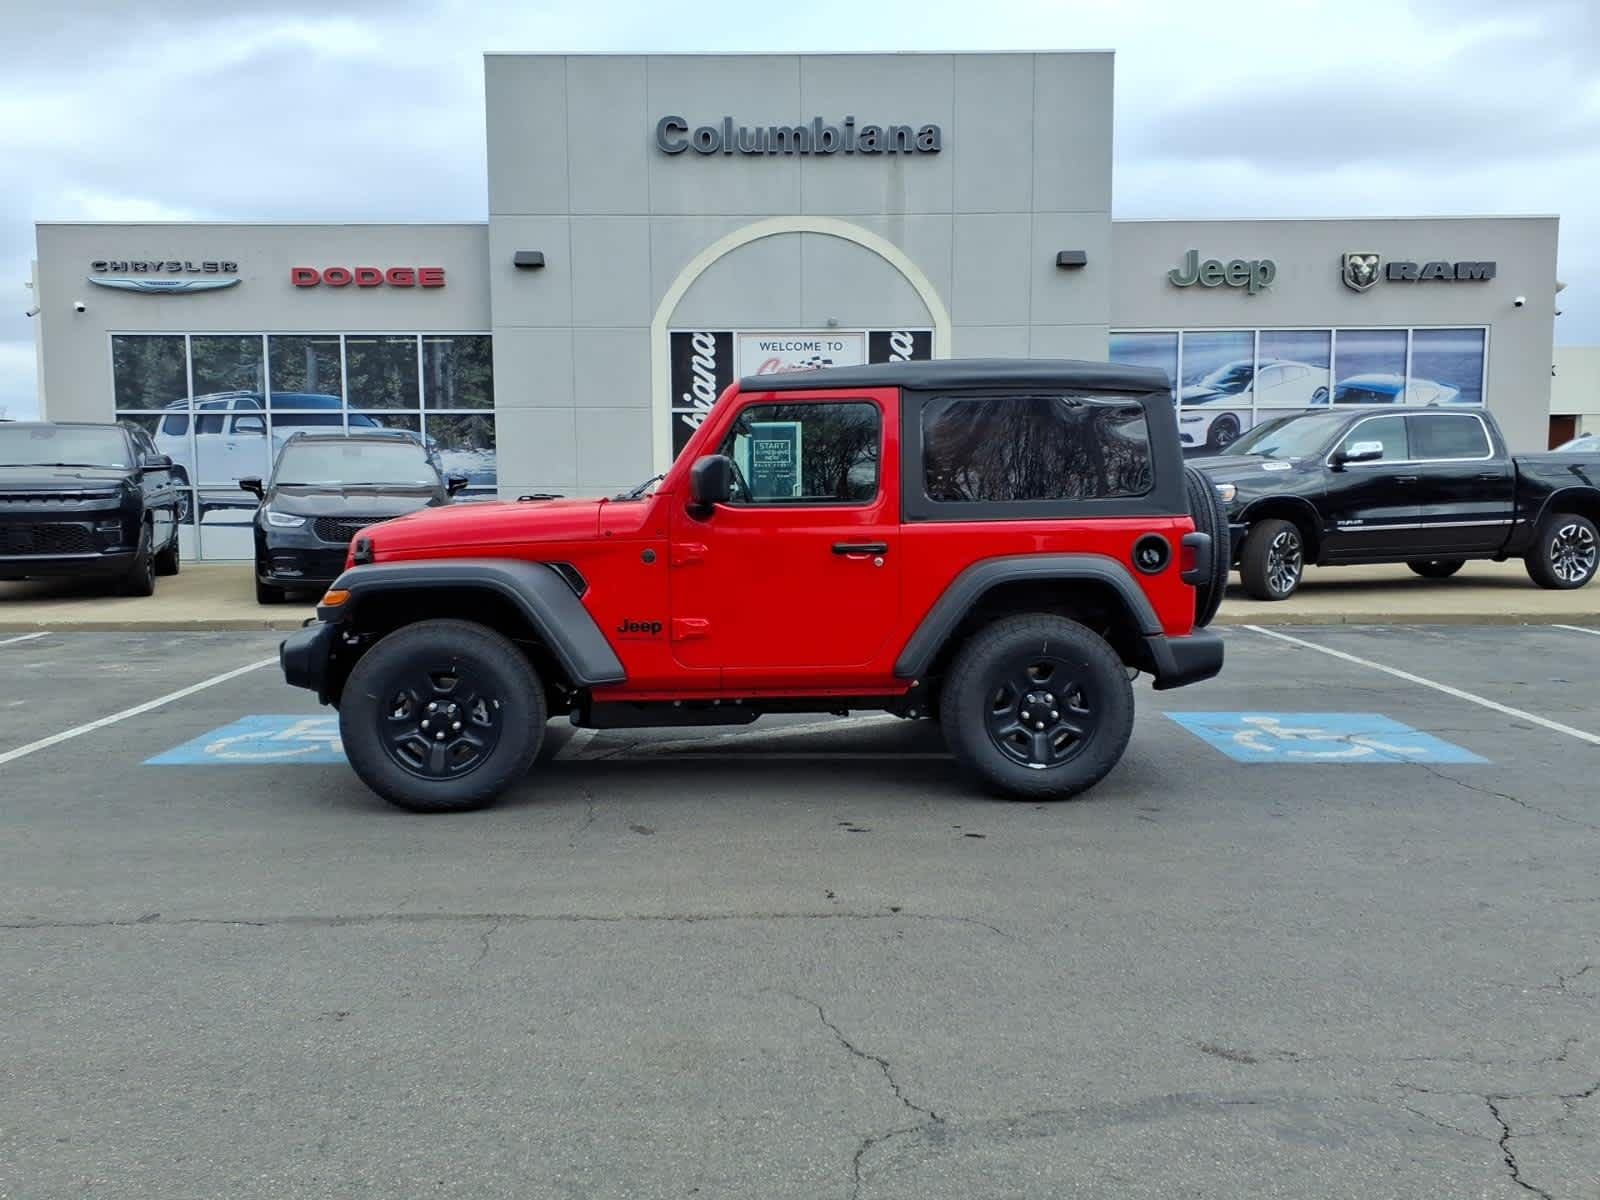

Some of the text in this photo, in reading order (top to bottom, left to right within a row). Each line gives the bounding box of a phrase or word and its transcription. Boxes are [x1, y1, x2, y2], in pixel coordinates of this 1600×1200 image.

[656, 115, 942, 153] Columbiana
[91, 260, 238, 272] CHRYSLER
[1168, 249, 1277, 295] Jeep
[1386, 261, 1496, 281] RAM
[291, 267, 446, 287] DODGE
[760, 342, 843, 351] WELCOME TO
[617, 619, 662, 635] Jeep
